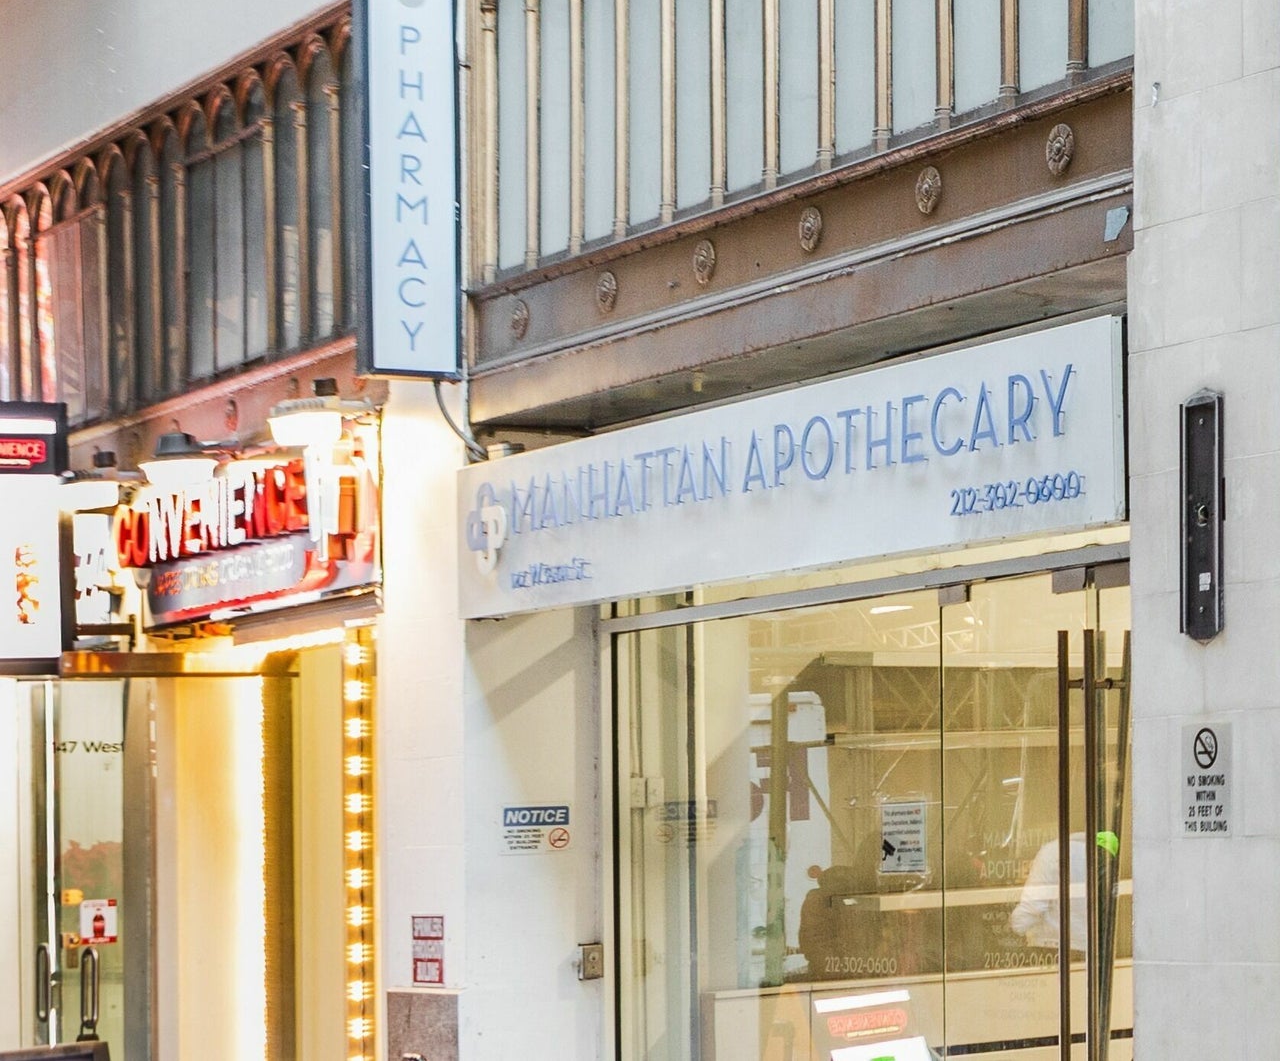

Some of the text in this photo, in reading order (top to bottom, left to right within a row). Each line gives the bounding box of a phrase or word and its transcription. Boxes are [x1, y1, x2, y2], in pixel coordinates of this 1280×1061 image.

[396, 25, 430, 352] PHARMACY
[509, 363, 1076, 536] MANHATTAN APOTHECARY
[950, 470, 1082, 516] 212-302-0600
[113, 459, 309, 568] CONVENIENCE
[1187, 774, 1225, 787] NO SMOKING
[1196, 790, 1216, 802] WITHIN
[505, 809, 567, 825] NOTICE
[1188, 804, 1223, 817] 25 FEET OF
[1185, 820, 1228, 832] THIS BUILDING
[823, 956, 898, 974] 212-302-0600
